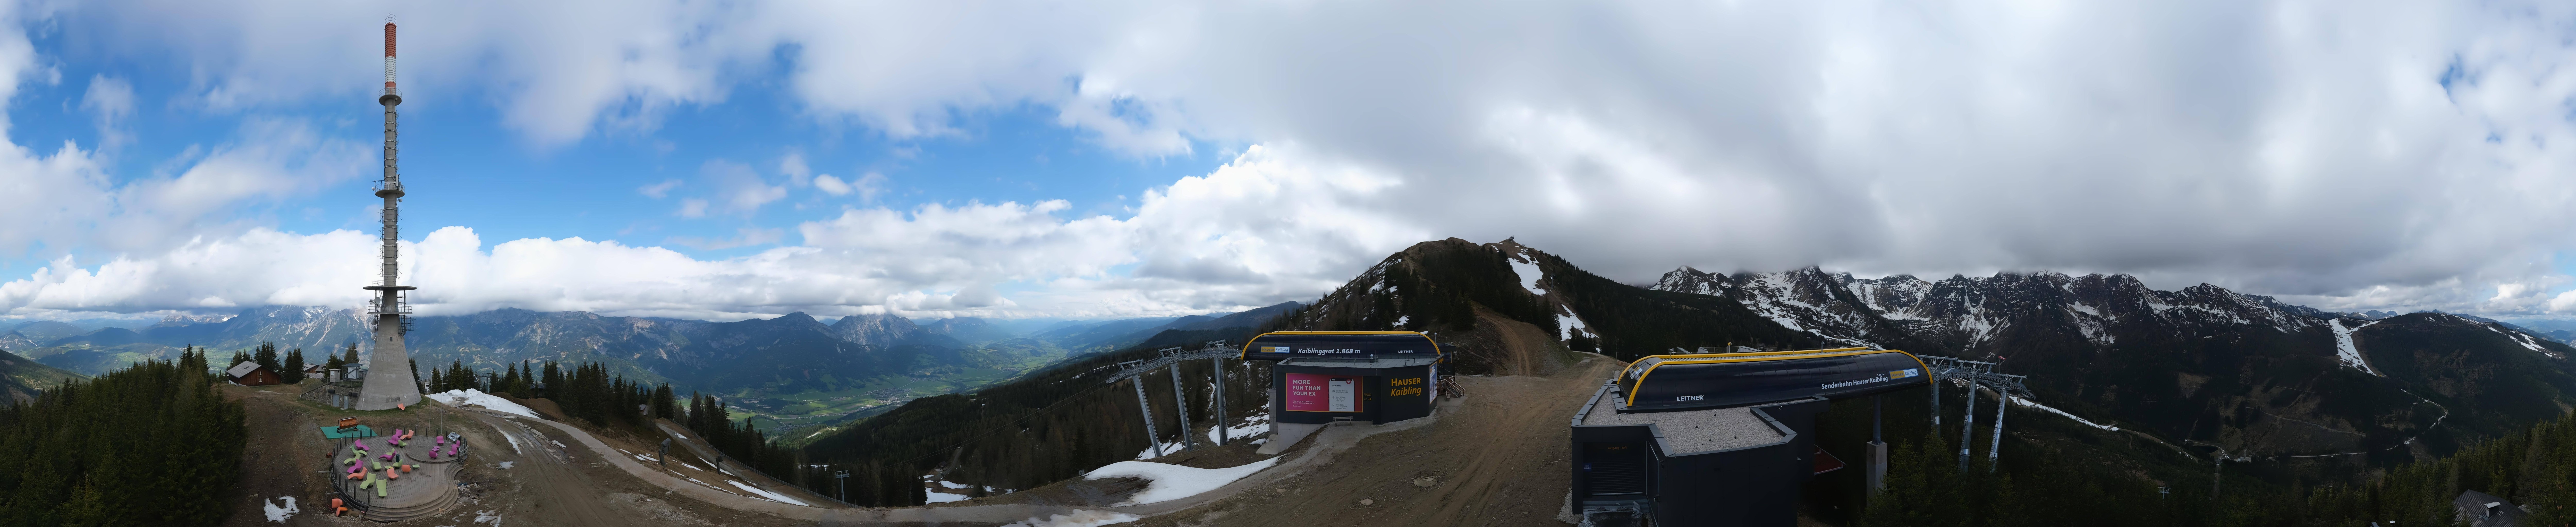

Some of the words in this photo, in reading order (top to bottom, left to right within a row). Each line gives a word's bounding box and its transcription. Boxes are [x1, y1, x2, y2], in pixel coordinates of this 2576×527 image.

[1391, 378, 1421, 386] HAUSER
[1821, 381, 1852, 389] Senderbahn
[1391, 387, 1421, 396] Kaibling
